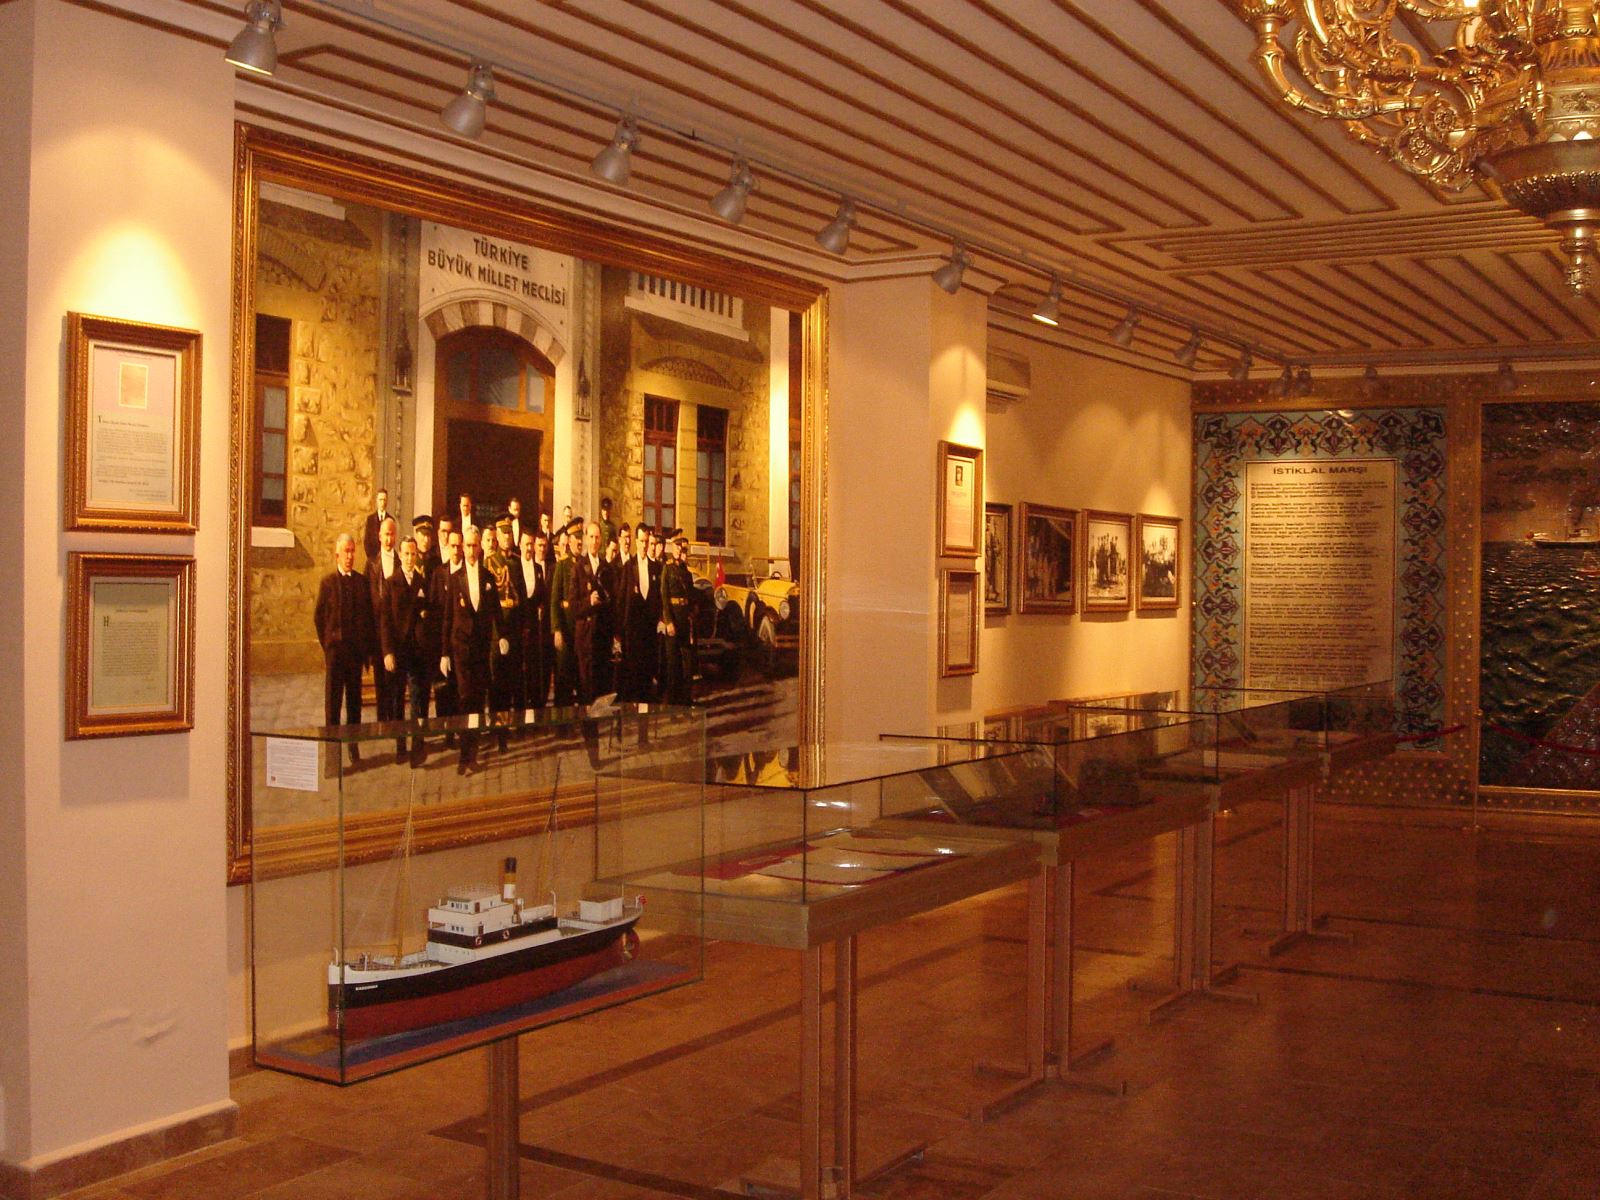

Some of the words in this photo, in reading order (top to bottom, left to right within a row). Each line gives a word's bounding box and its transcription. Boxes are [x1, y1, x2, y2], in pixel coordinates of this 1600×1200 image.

[473, 236, 529, 270] TÜRKİYE
[427, 247, 472, 278] BÜYÜK
[478, 263, 518, 292] MİLLET
[522, 279, 566, 306] MECLİSİ
[1273, 466, 1326, 475] İSTİKLAL
[1328, 466, 1368, 475] MARŞI
